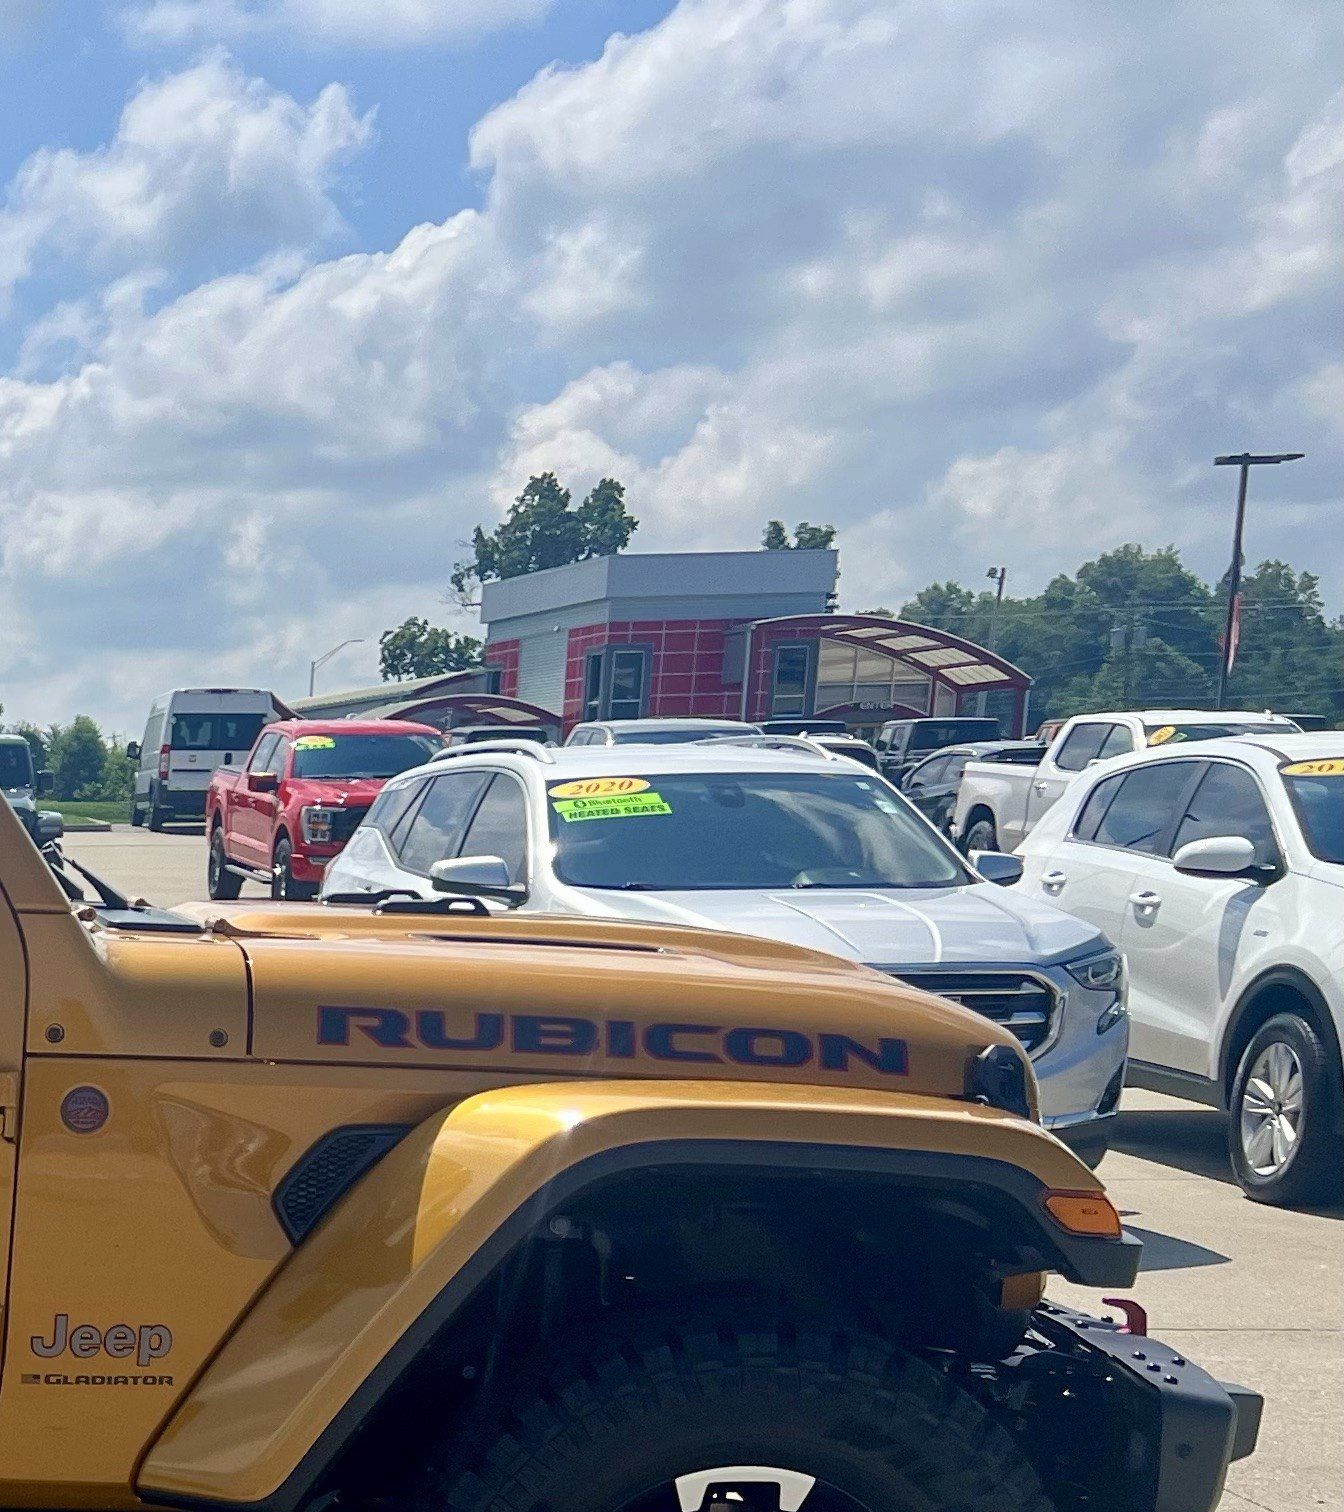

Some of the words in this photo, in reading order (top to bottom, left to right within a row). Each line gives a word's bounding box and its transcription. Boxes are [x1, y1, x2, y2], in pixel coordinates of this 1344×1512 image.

[569, 779, 633, 796] 2020
[569, 808, 621, 819] HEATED
[624, 804, 667, 815] SEATS
[317, 1004, 910, 1077] RUBICON
[30, 1313, 173, 1367] Jeep
[44, 1374, 174, 1387] GLADIATOR
